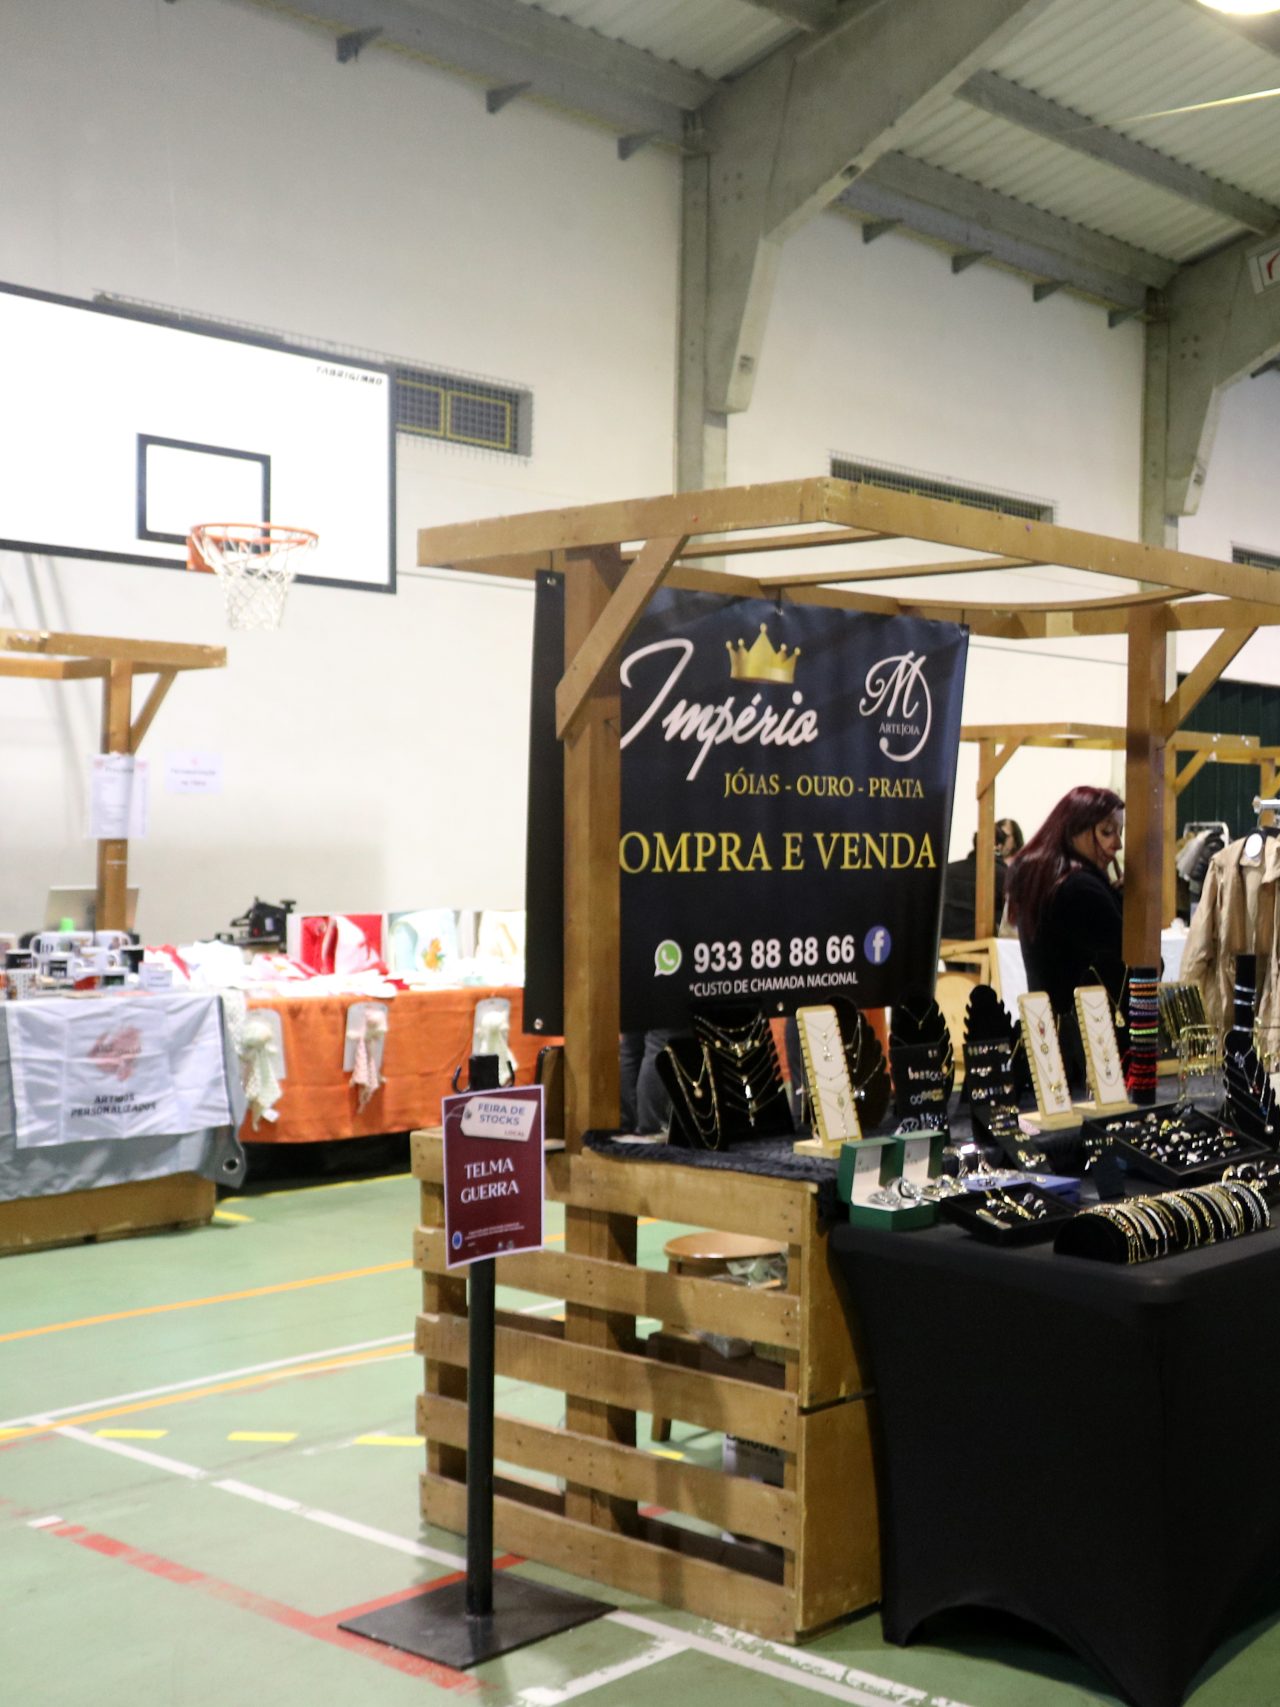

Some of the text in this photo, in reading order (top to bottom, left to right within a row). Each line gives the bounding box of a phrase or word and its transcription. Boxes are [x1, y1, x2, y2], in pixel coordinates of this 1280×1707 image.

[620, 638, 819, 781] Império
[724, 767, 780, 798] JÓIAS
[796, 774, 854, 797] OURO
[868, 777, 925, 798] PRATA
[619, 831, 936, 874] OMPRA E VENDA
[694, 935, 855, 974] 933 88 88 66
[734, 979, 749, 994] DE
[750, 975, 805, 993] CHAMADA
[806, 972, 858, 988] NACIONAL
[478, 1103, 526, 1115] FEIRA DE
[480, 1114, 520, 1126] STOCKS
[464, 1157, 514, 1180] TELMA
[460, 1180, 520, 1204] GUERRA
